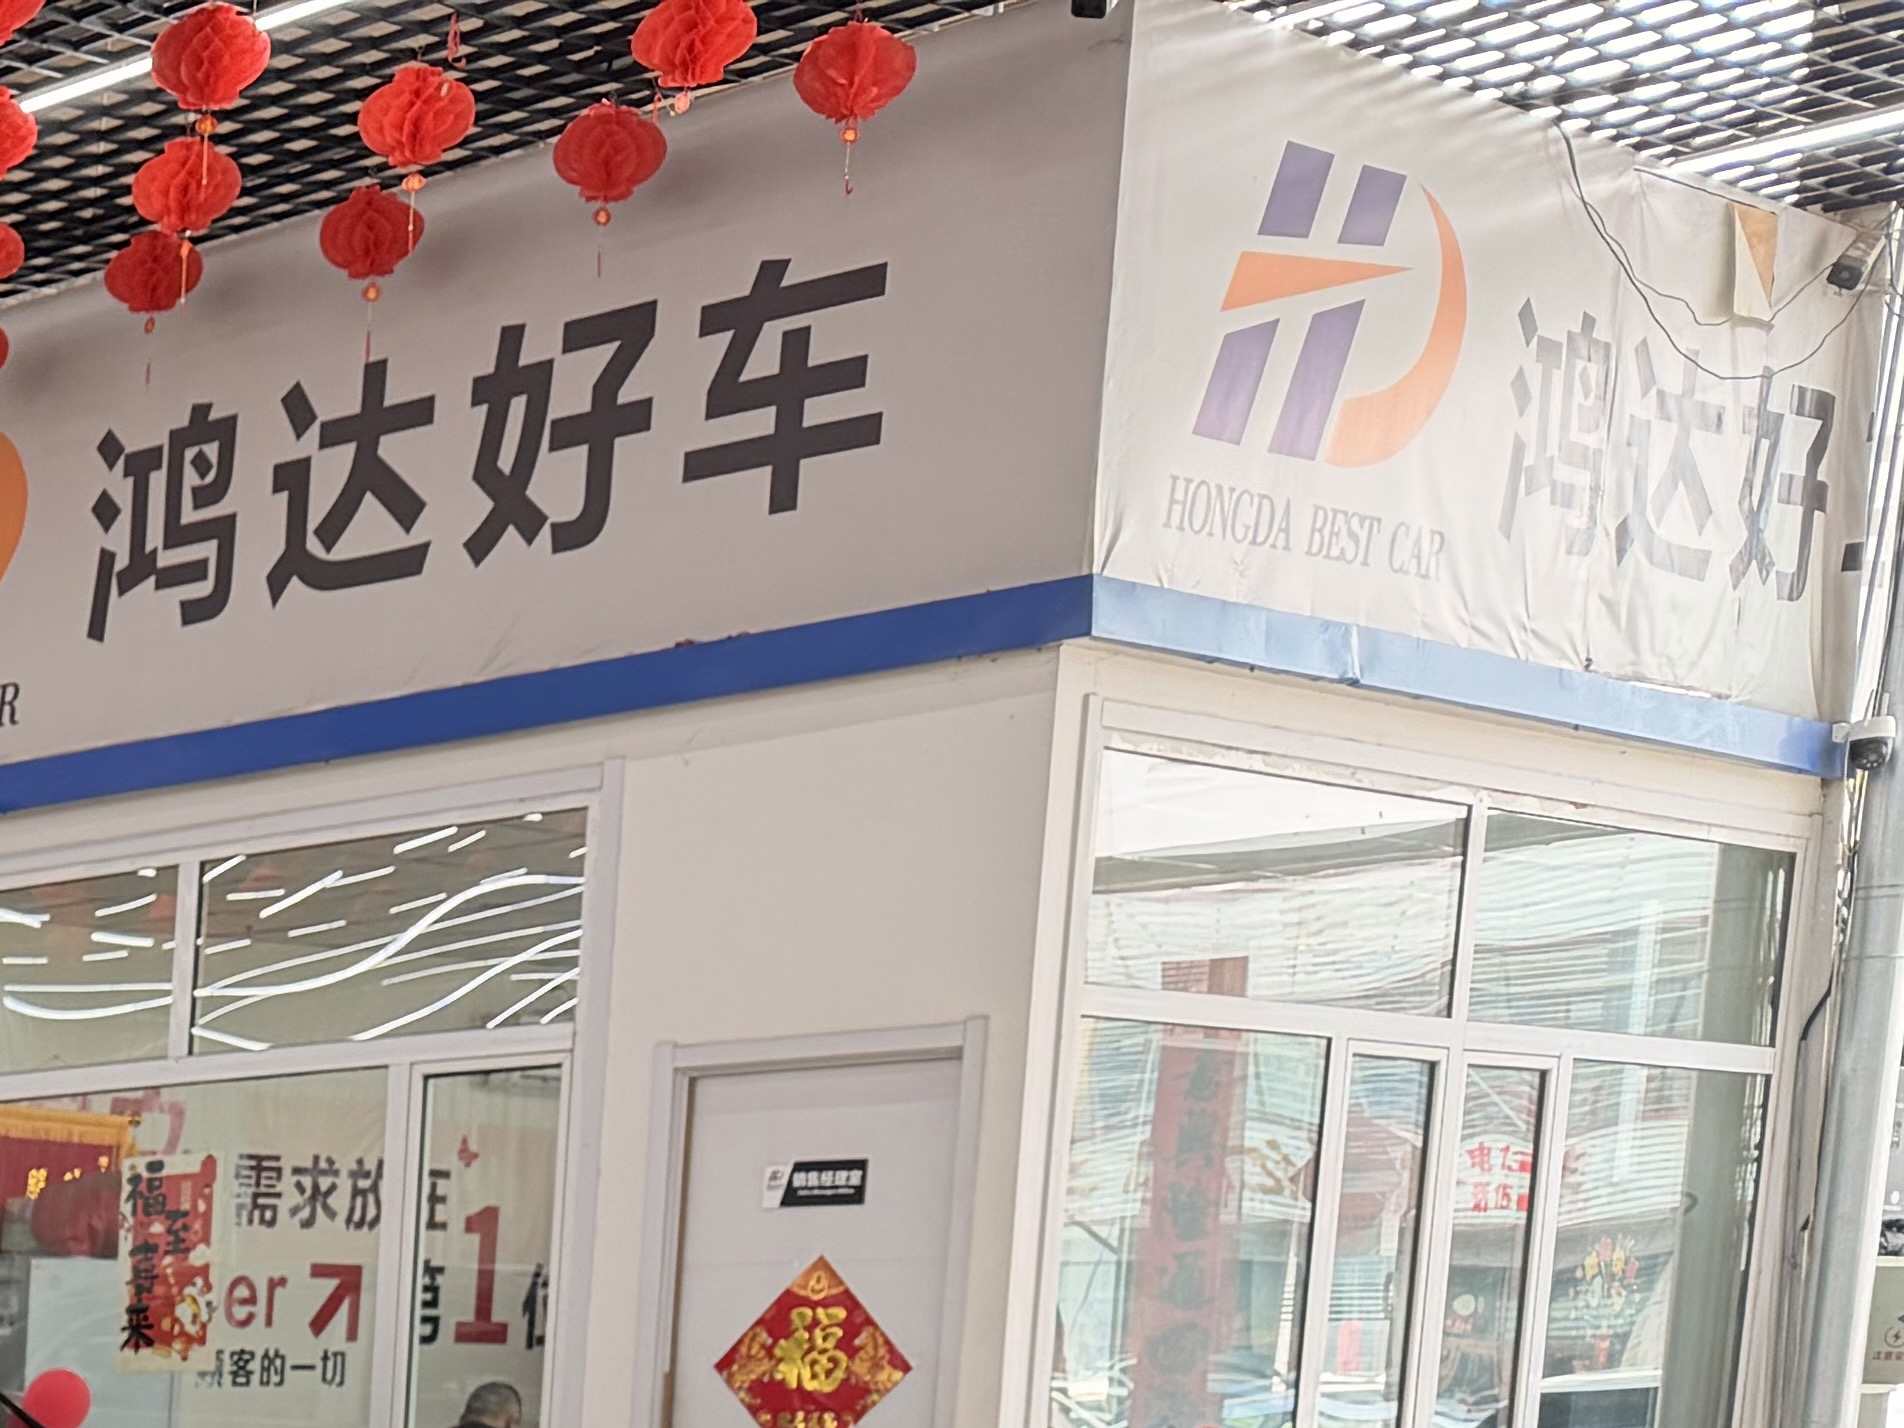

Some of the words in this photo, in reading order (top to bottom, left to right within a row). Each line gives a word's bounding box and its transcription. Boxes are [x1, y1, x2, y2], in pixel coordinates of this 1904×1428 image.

[84, 258, 889, 642] 鸿达好车
[1161, 474, 1293, 551] HONGDA
[1304, 503, 1383, 567] BEST
[1388, 520, 1447, 582] CAR
[1498, 297, 1837, 602] 鸿达好
[774, 1306, 848, 1393] 福
